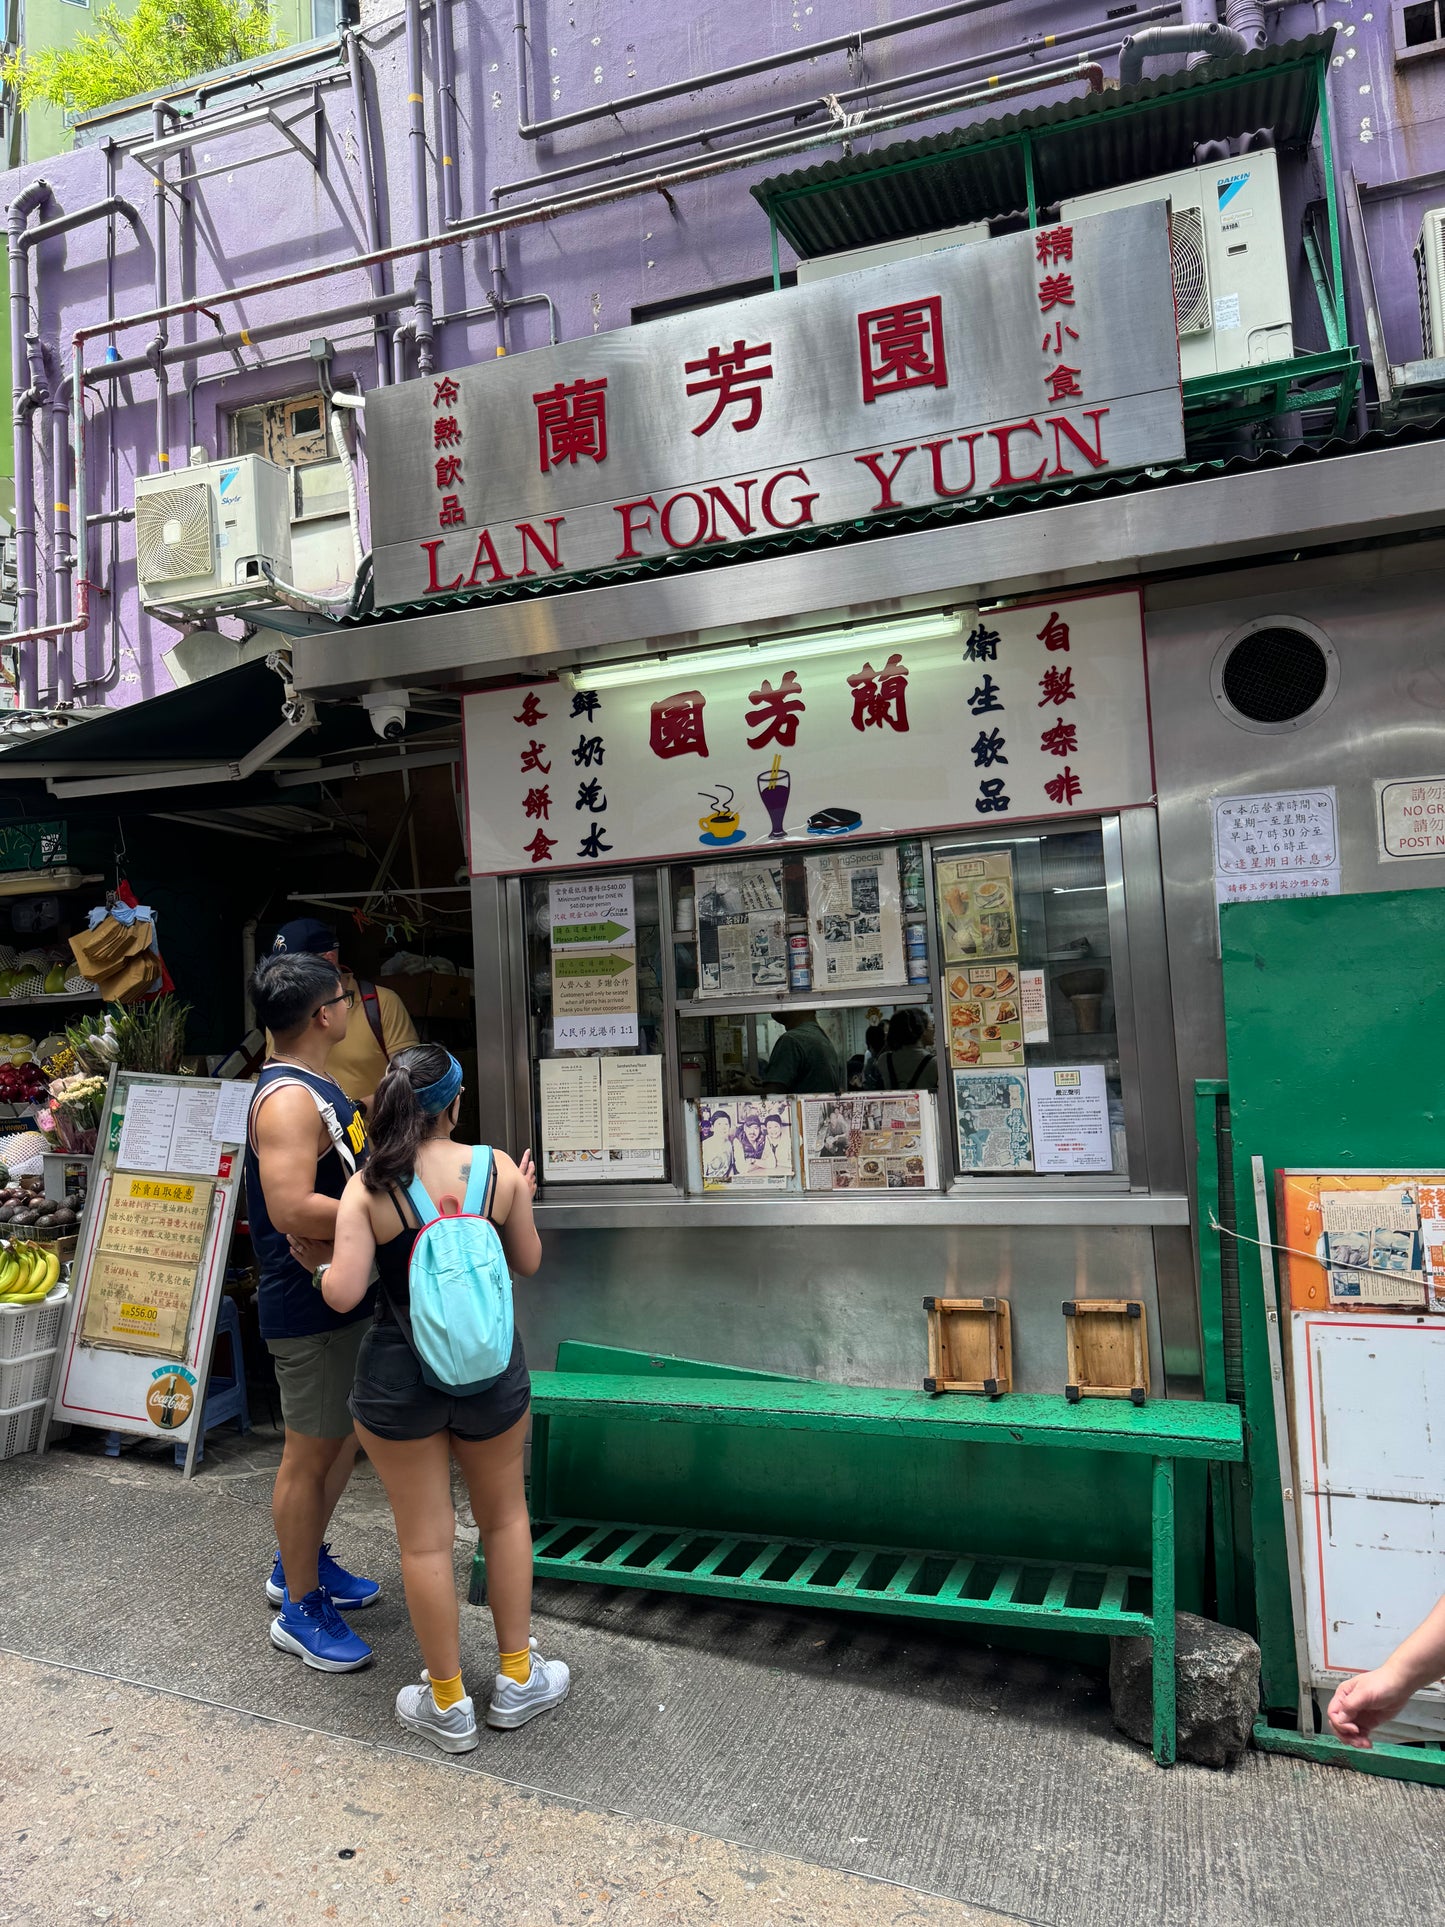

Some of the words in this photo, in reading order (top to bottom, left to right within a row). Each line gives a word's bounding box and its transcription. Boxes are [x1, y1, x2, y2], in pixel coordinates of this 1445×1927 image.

[1217, 172, 1251, 185] DAIKIN
[1035, 226, 1083, 403] 精美小食
[533, 296, 948, 473] 蘭芳園
[433, 376, 465, 528] 冷熱飲品
[420, 516, 566, 594] LAN
[613, 469, 820, 562] FONG
[854, 408, 1111, 511] YUEN
[513, 691, 559, 863] 各式餅食
[1237, 799, 1310, 815] 本店營業時間
[1404, 805, 1423, 816] NO
[1233, 814, 1319, 829] 星期一至星期六
[1400, 836, 1431, 848] POST
[1235, 853, 1321, 869] 逢星期日休息
[583, 910, 598, 918] Cash
[620, 1025, 634, 1034] 1:1
[131, 1183, 193, 1201] 外賣自取優惠
[149, 1390, 190, 1411] Coca-Cola
